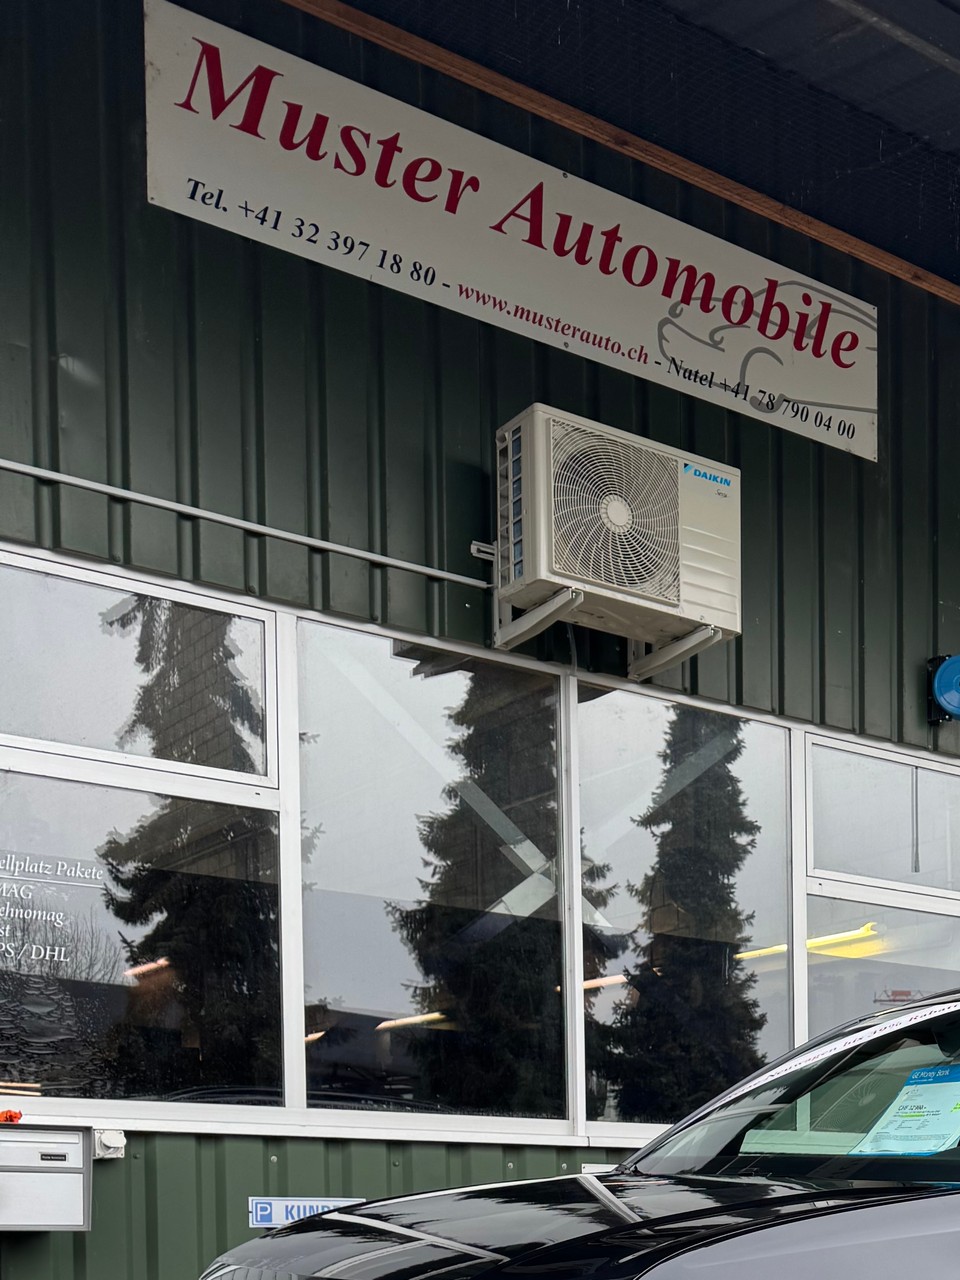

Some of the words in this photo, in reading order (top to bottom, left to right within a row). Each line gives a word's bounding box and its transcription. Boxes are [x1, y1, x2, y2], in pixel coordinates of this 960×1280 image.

[174, 36, 480, 214] Muster
[489, 181, 860, 369] Automobile
[187, 178, 228, 213] Tel.
[238, 200, 282, 231] +41
[291, 217, 320, 244] 32
[327, 230, 370, 261] 397
[377, 249, 403, 274] 18
[410, 261, 436, 286] 80
[457, 283, 649, 364] www.musterauto.ch
[668, 356, 715, 389] Natel
[720, 378, 750, 402] +41
[757, 389, 776, 410] 78
[782, 398, 810, 423] 790
[815, 411, 833, 432] 04
[838, 419, 857, 440] 00
[693, 468, 732, 487] DAIKIN
[56, 861, 104, 880] Pakete
[31, 944, 70, 962] DHL
